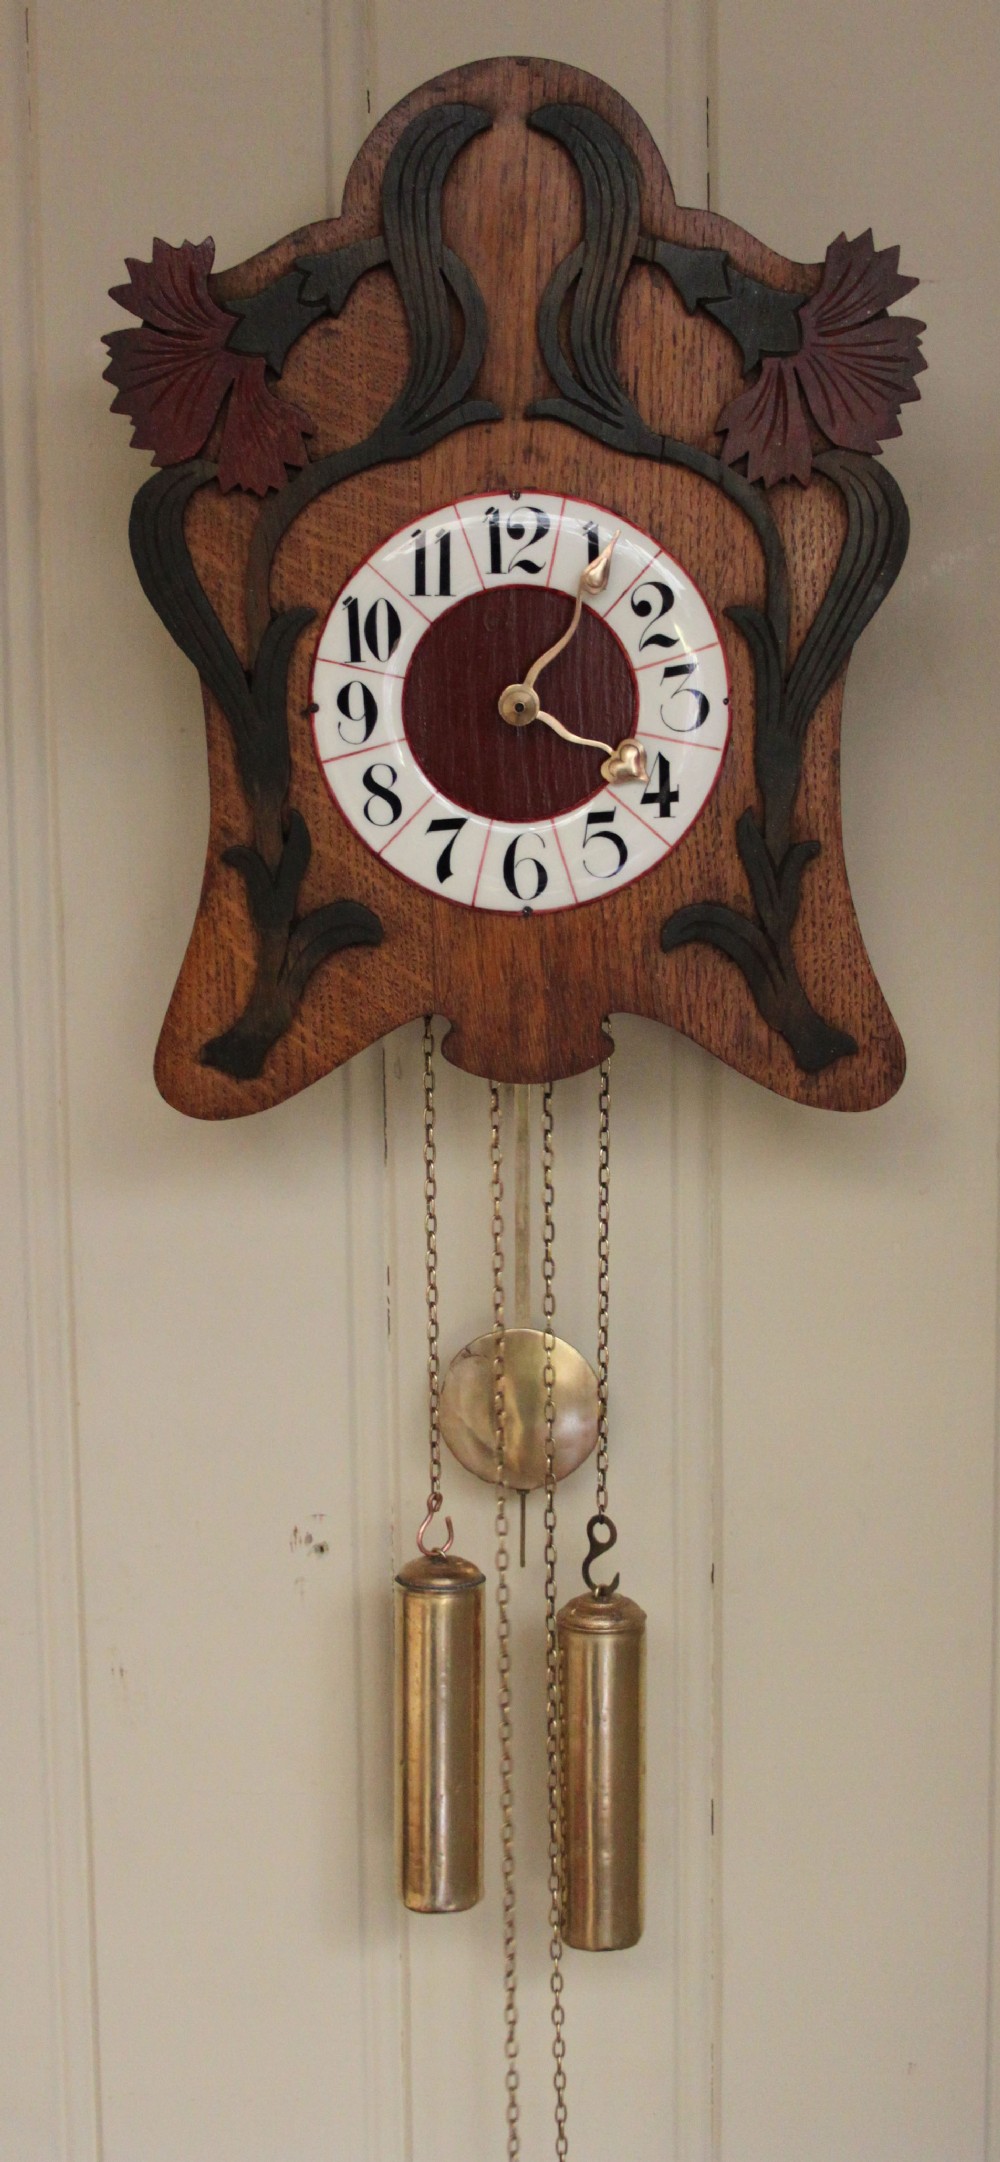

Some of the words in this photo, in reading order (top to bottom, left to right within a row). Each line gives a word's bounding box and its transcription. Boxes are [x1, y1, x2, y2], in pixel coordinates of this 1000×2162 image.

[409, 529, 457, 597] 11
[484, 506, 550, 575] 12
[342, 596, 401, 664] 10
[630, 581, 680, 651] 2
[336, 680, 378, 744] 9
[660, 663, 710, 732] 3
[362, 763, 402, 826] 8
[640, 751, 679, 818] 4
[425, 817, 469, 884] 7
[503, 832, 548, 900] 6
[582, 806, 628, 878] 5
